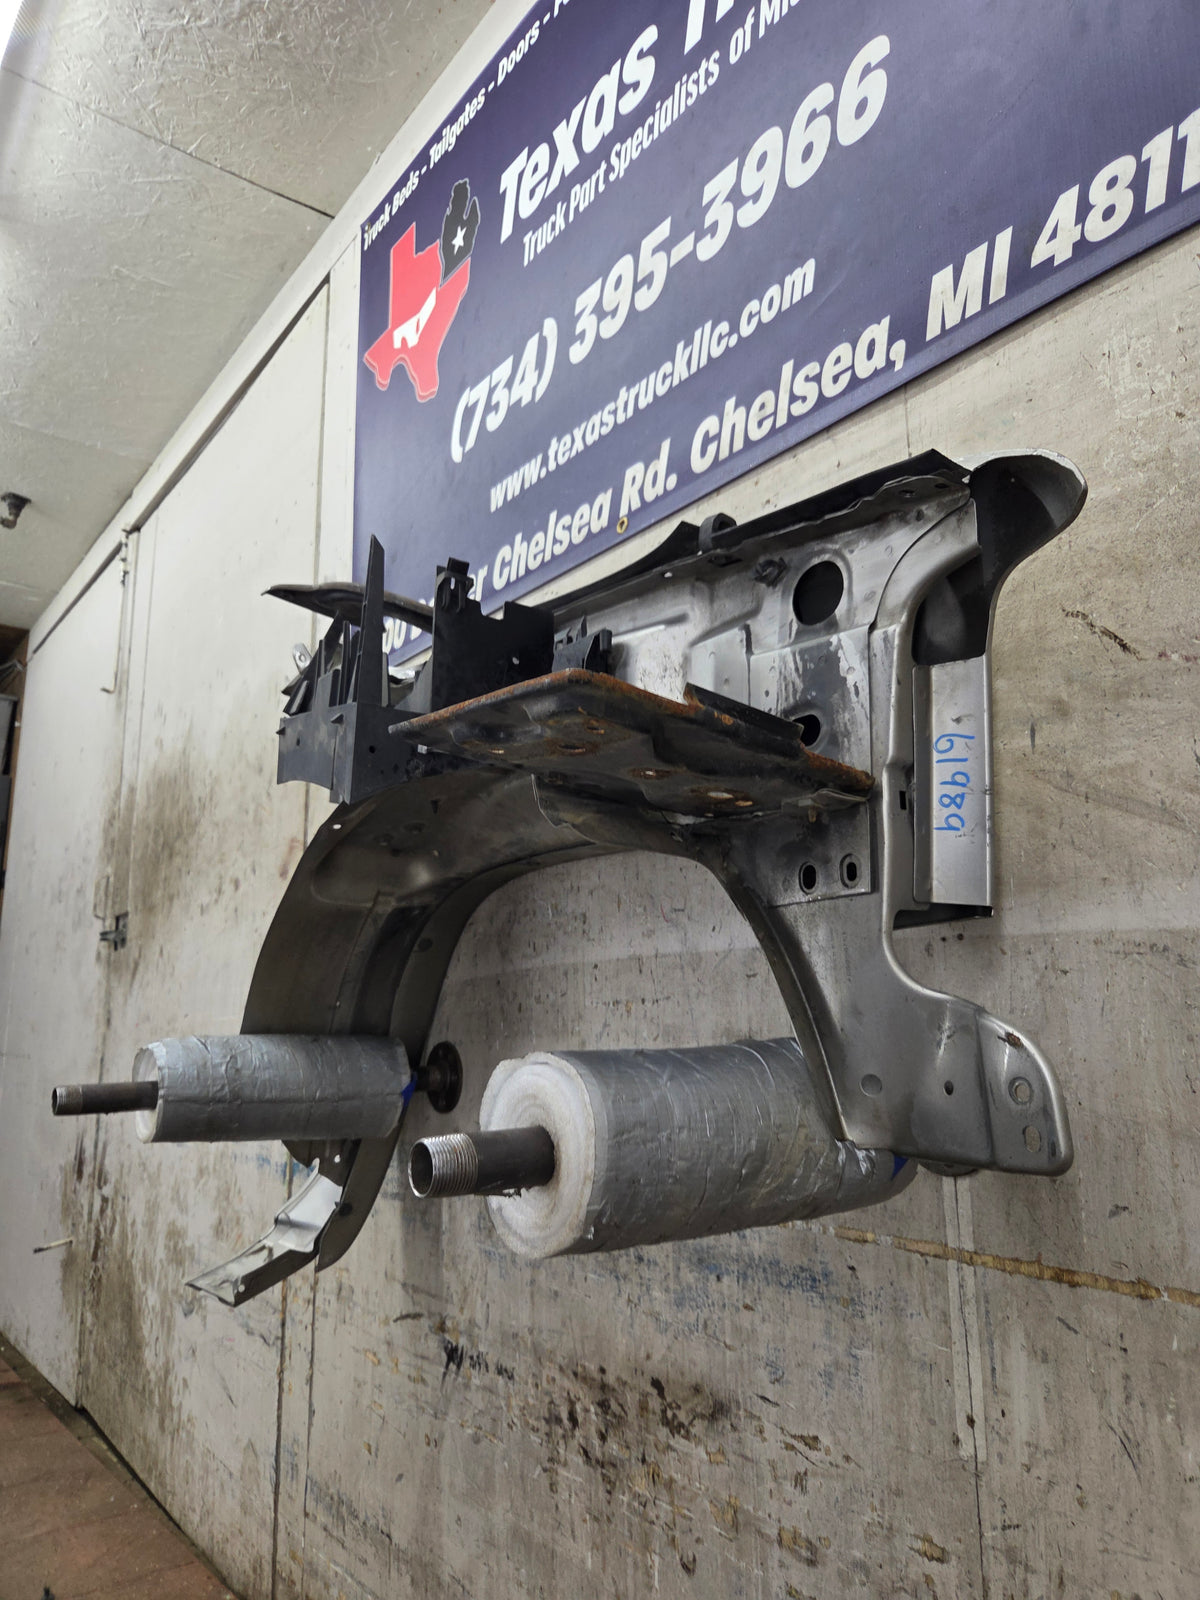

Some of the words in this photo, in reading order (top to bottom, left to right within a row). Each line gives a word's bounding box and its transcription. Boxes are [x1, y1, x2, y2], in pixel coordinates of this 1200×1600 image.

[364, 202, 392, 251] Truck
[391, 170, 420, 216] Beds
[429, 87, 486, 169] Tailgates
[497, 20, 540, 86] Doors
[451, 316, 559, 464] (734)
[569, 34, 891, 365] 395-3966
[500, 24, 659, 245] Texas
[522, 200, 568, 268] Truck
[568, 159, 608, 224] Part
[608, 50, 720, 182] Specialists
[729, 6, 756, 65] of
[490, 257, 816, 513] www.texastruckllc.com
[492, 488, 613, 591] Chelsea
[619, 437, 678, 519] Rd.
[690, 314, 906, 474] Chelsea,
[926, 225, 1013, 342] MI
[933, 733, 976, 832] 61989
